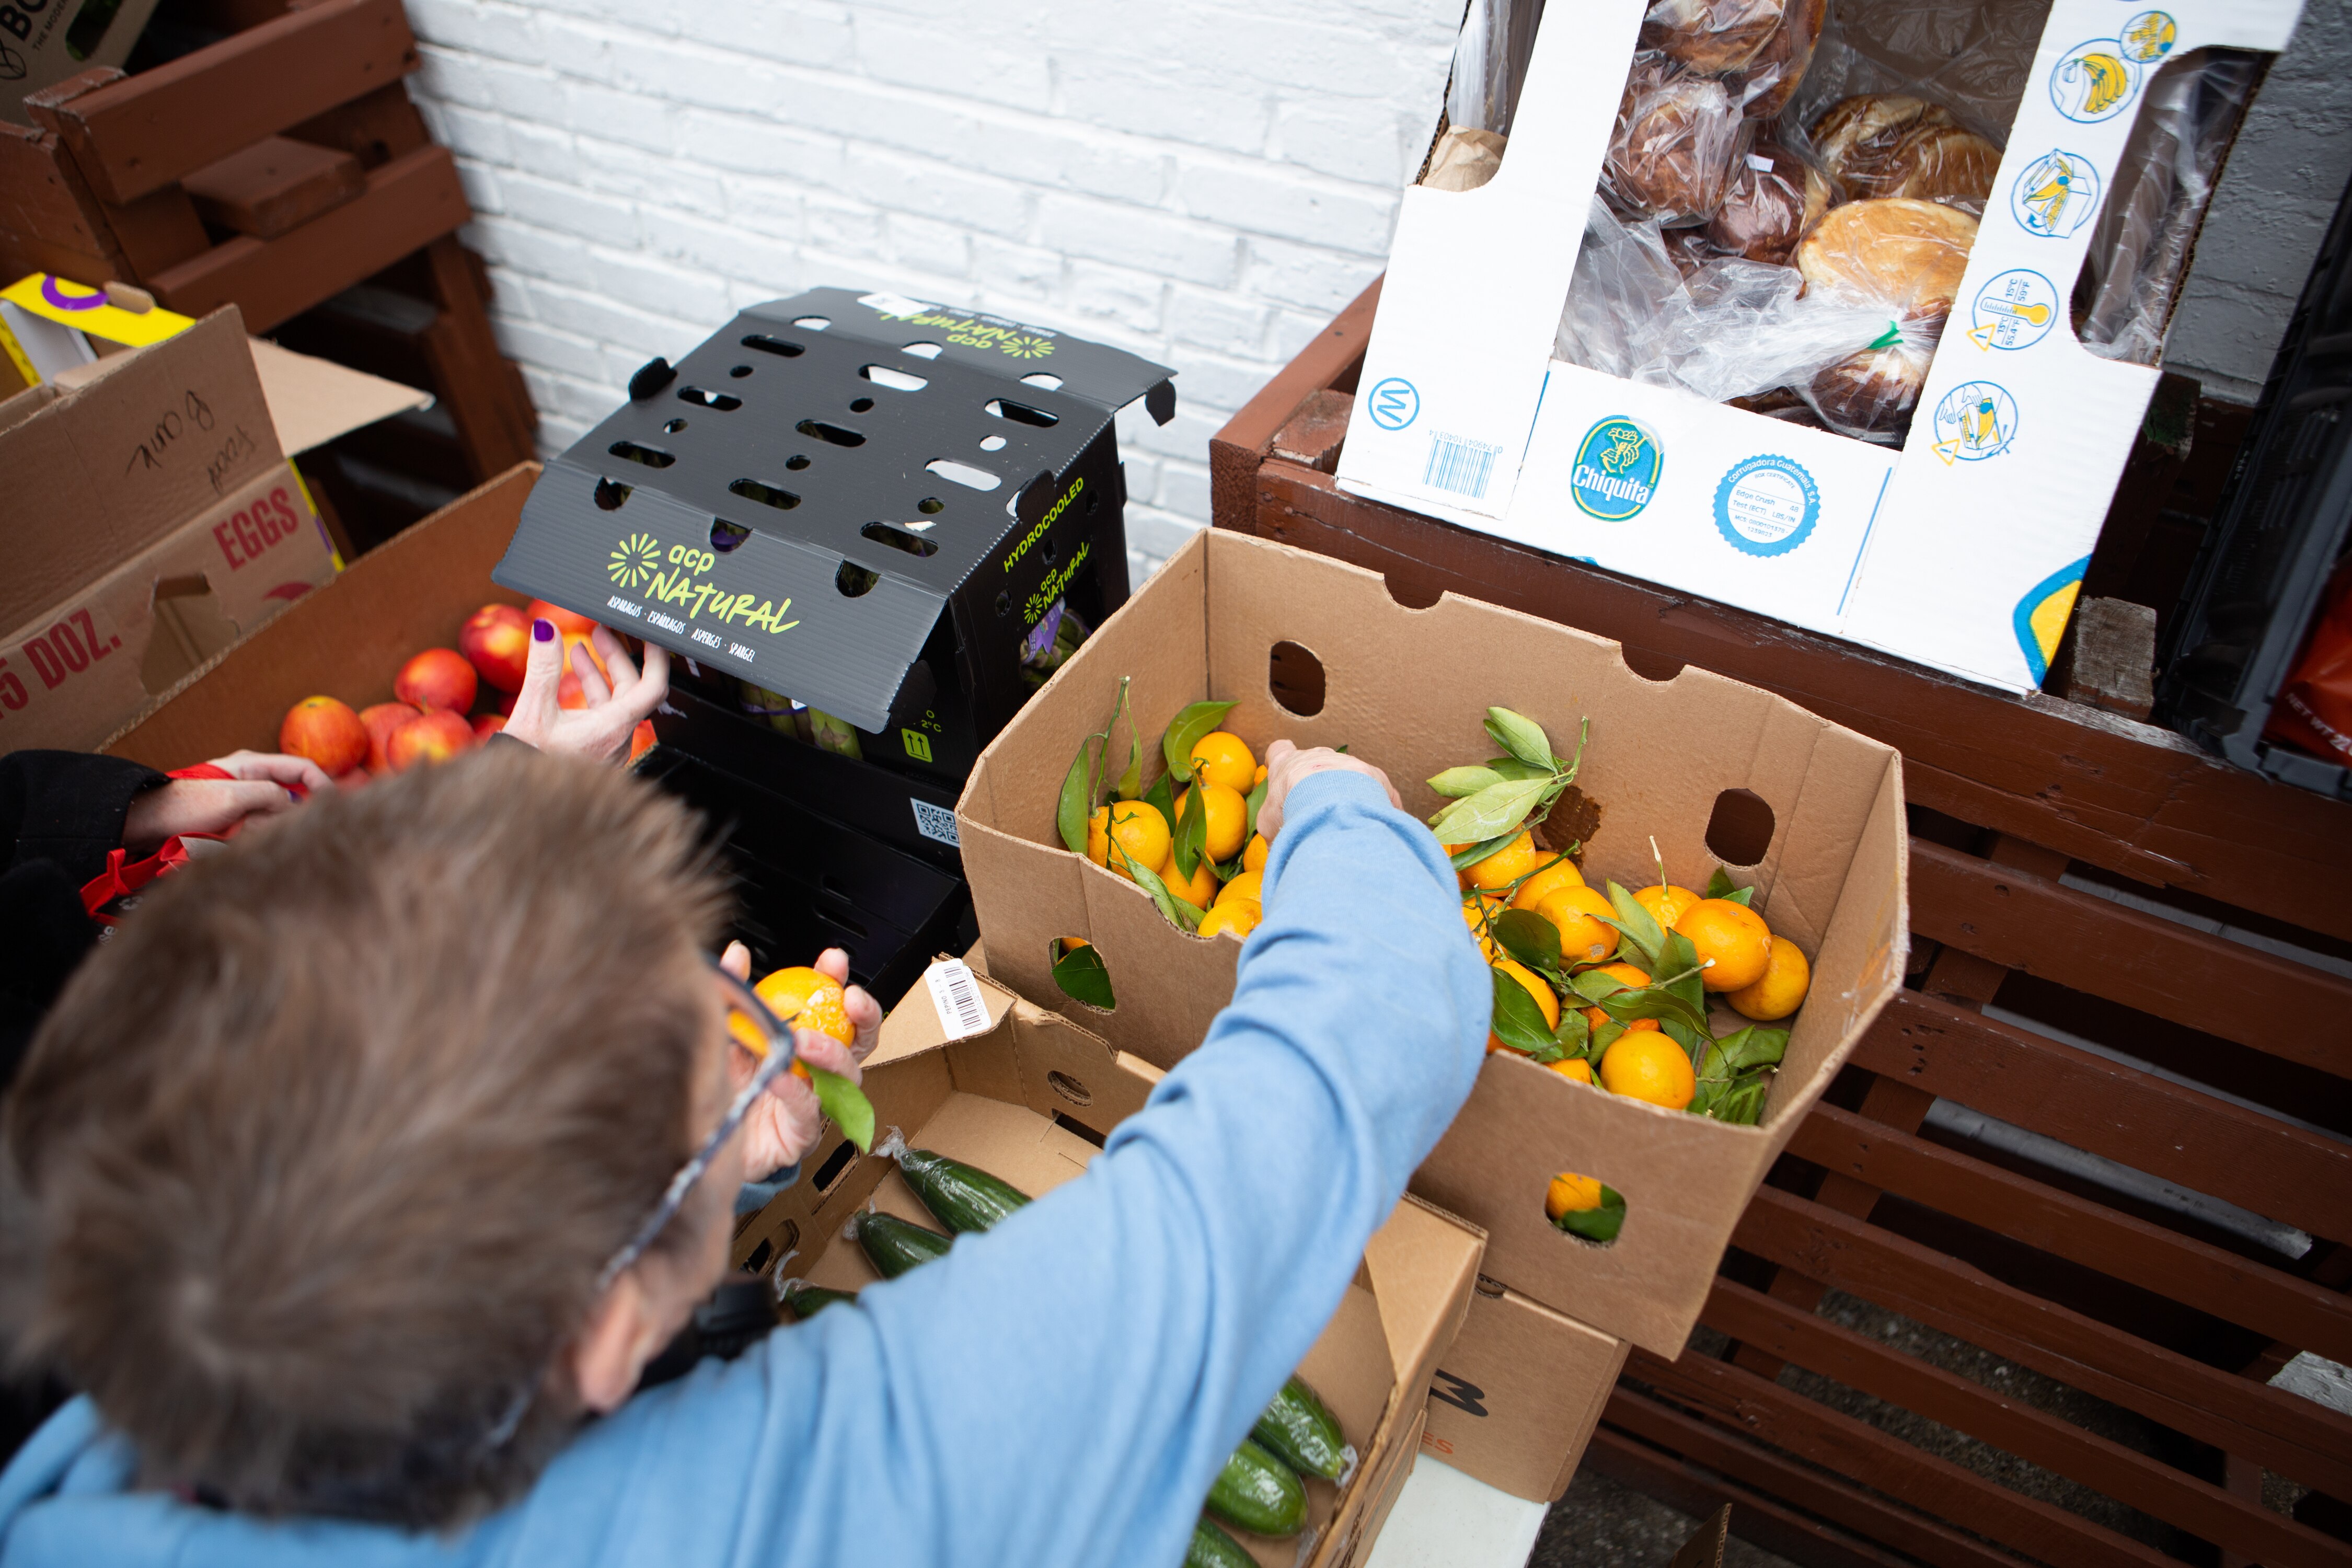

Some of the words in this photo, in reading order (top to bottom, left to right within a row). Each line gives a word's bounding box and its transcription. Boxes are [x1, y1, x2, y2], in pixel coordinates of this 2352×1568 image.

[32, 30, 49, 51] THE
[947, 333, 993, 349] acp
[124, 389, 215, 477] Bank
[1573, 465, 1650, 504] Chiquita
[1727, 459, 1775, 483] Corrugadora
[1777, 459, 1812, 491] Guatemala,
[1766, 472, 1796, 490] CERTIFICATE
[1733, 500, 1747, 510] Test
[1749, 505, 1767, 515] (ECT)
[1772, 511, 1796, 523] LBS/IN
[1736, 490, 1754, 500] Edge
[1755, 495, 1775, 505] Crush
[212, 487, 299, 572] EGGS
[1004, 477, 1084, 573] HYDROCOOLED
[668, 545, 715, 577] acp
[1043, 541, 1090, 610] NATURAL
[1040, 569, 1057, 592] acp
[644, 567, 800, 634] NATURAL
[607, 595, 643, 618] ASPARAGUS
[647, 612, 687, 635] ESPÁRRAGOS
[691, 628, 723, 649] ASPERGES
[728, 642, 756, 663] SPARGEL
[22, 607, 123, 691] DOZ.
[2285, 692, 2313, 717] NET
[2310, 716, 2337, 736] WT
[941, 995, 952, 1014] PEPINO
